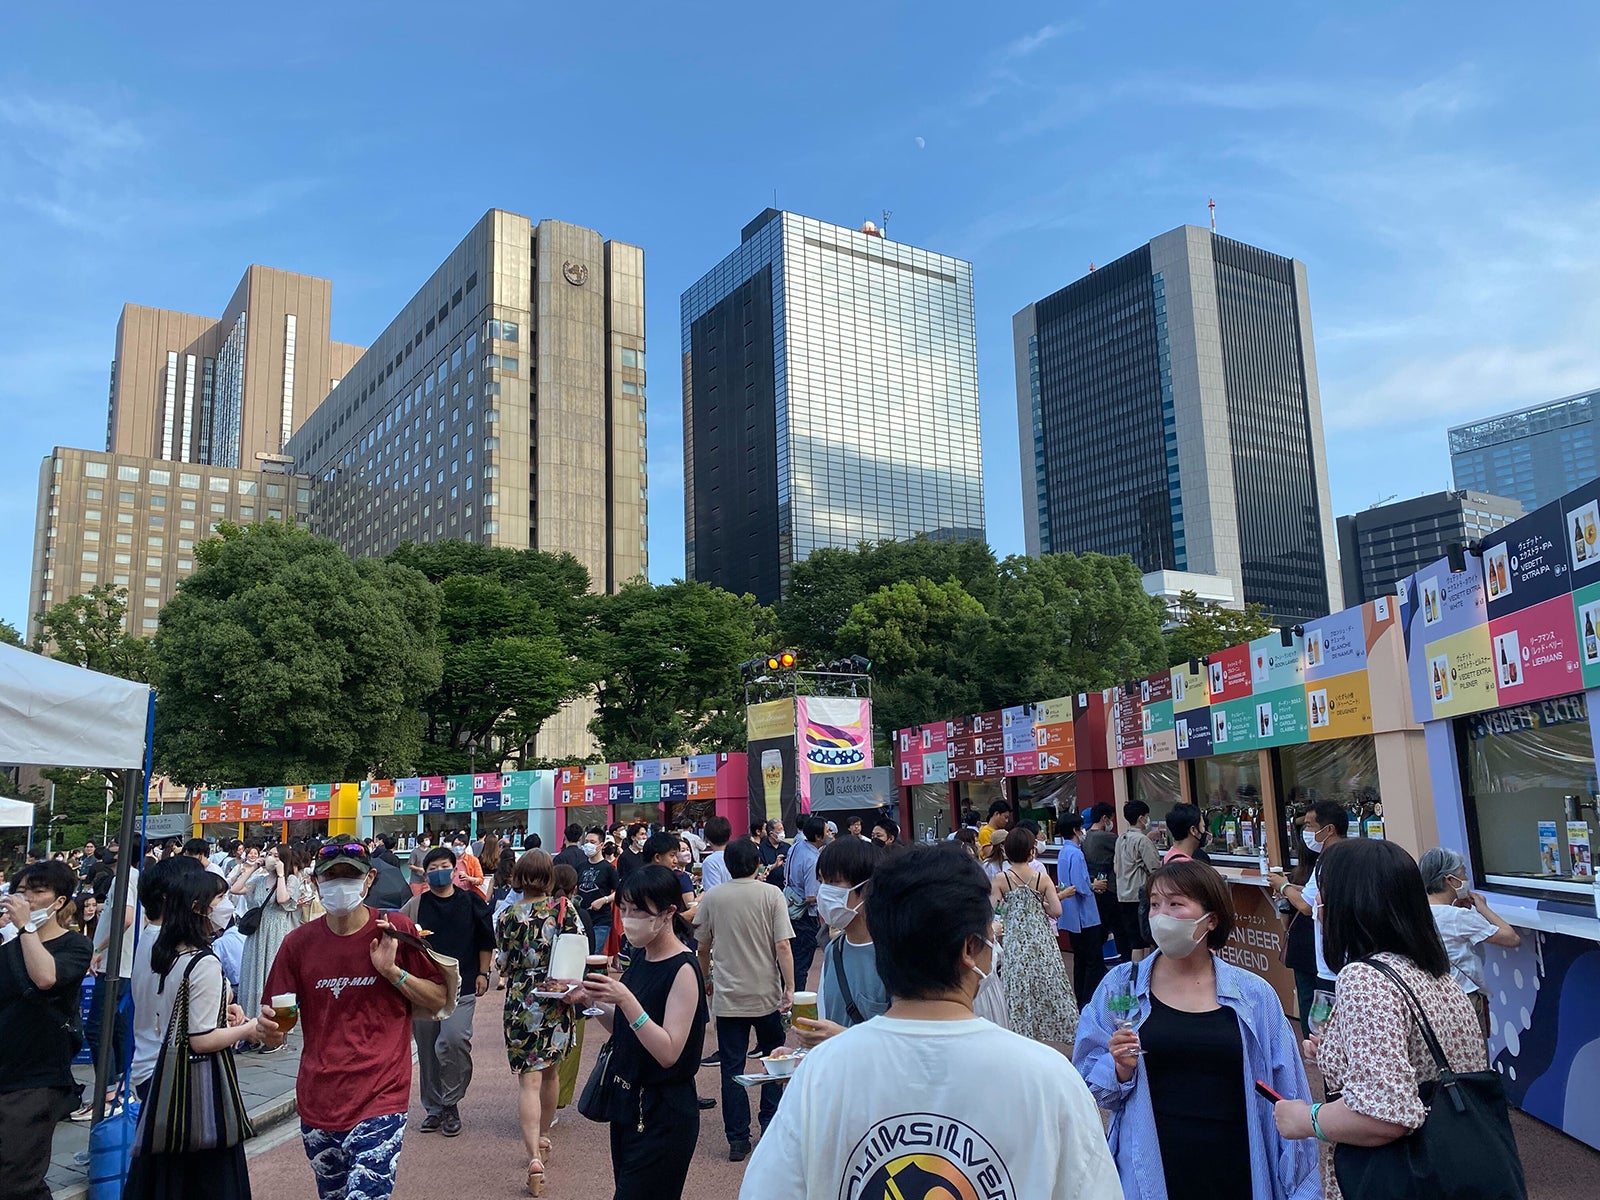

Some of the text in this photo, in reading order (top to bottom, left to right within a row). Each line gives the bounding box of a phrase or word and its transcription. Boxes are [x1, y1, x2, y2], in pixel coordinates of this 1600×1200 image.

[1521, 556, 1544, 571] VEDETT
[1522, 565, 1551, 582] EXTRA IPA
[1449, 585, 1481, 602] VEDETT EXTRA
[1378, 605, 1385, 613] 5
[1449, 601, 1464, 611] WHITE
[1532, 652, 1563, 667] LIEFMANS
[1458, 667, 1491, 681] VEDETT EXTRA
[1459, 680, 1478, 689] PILSNER
[1484, 705, 1533, 735] VEDETT
[836, 783, 874, 794] GLASS RINSER
[1247, 928, 1282, 952] BEER
[315, 976, 377, 990] SPIDER-MAN
